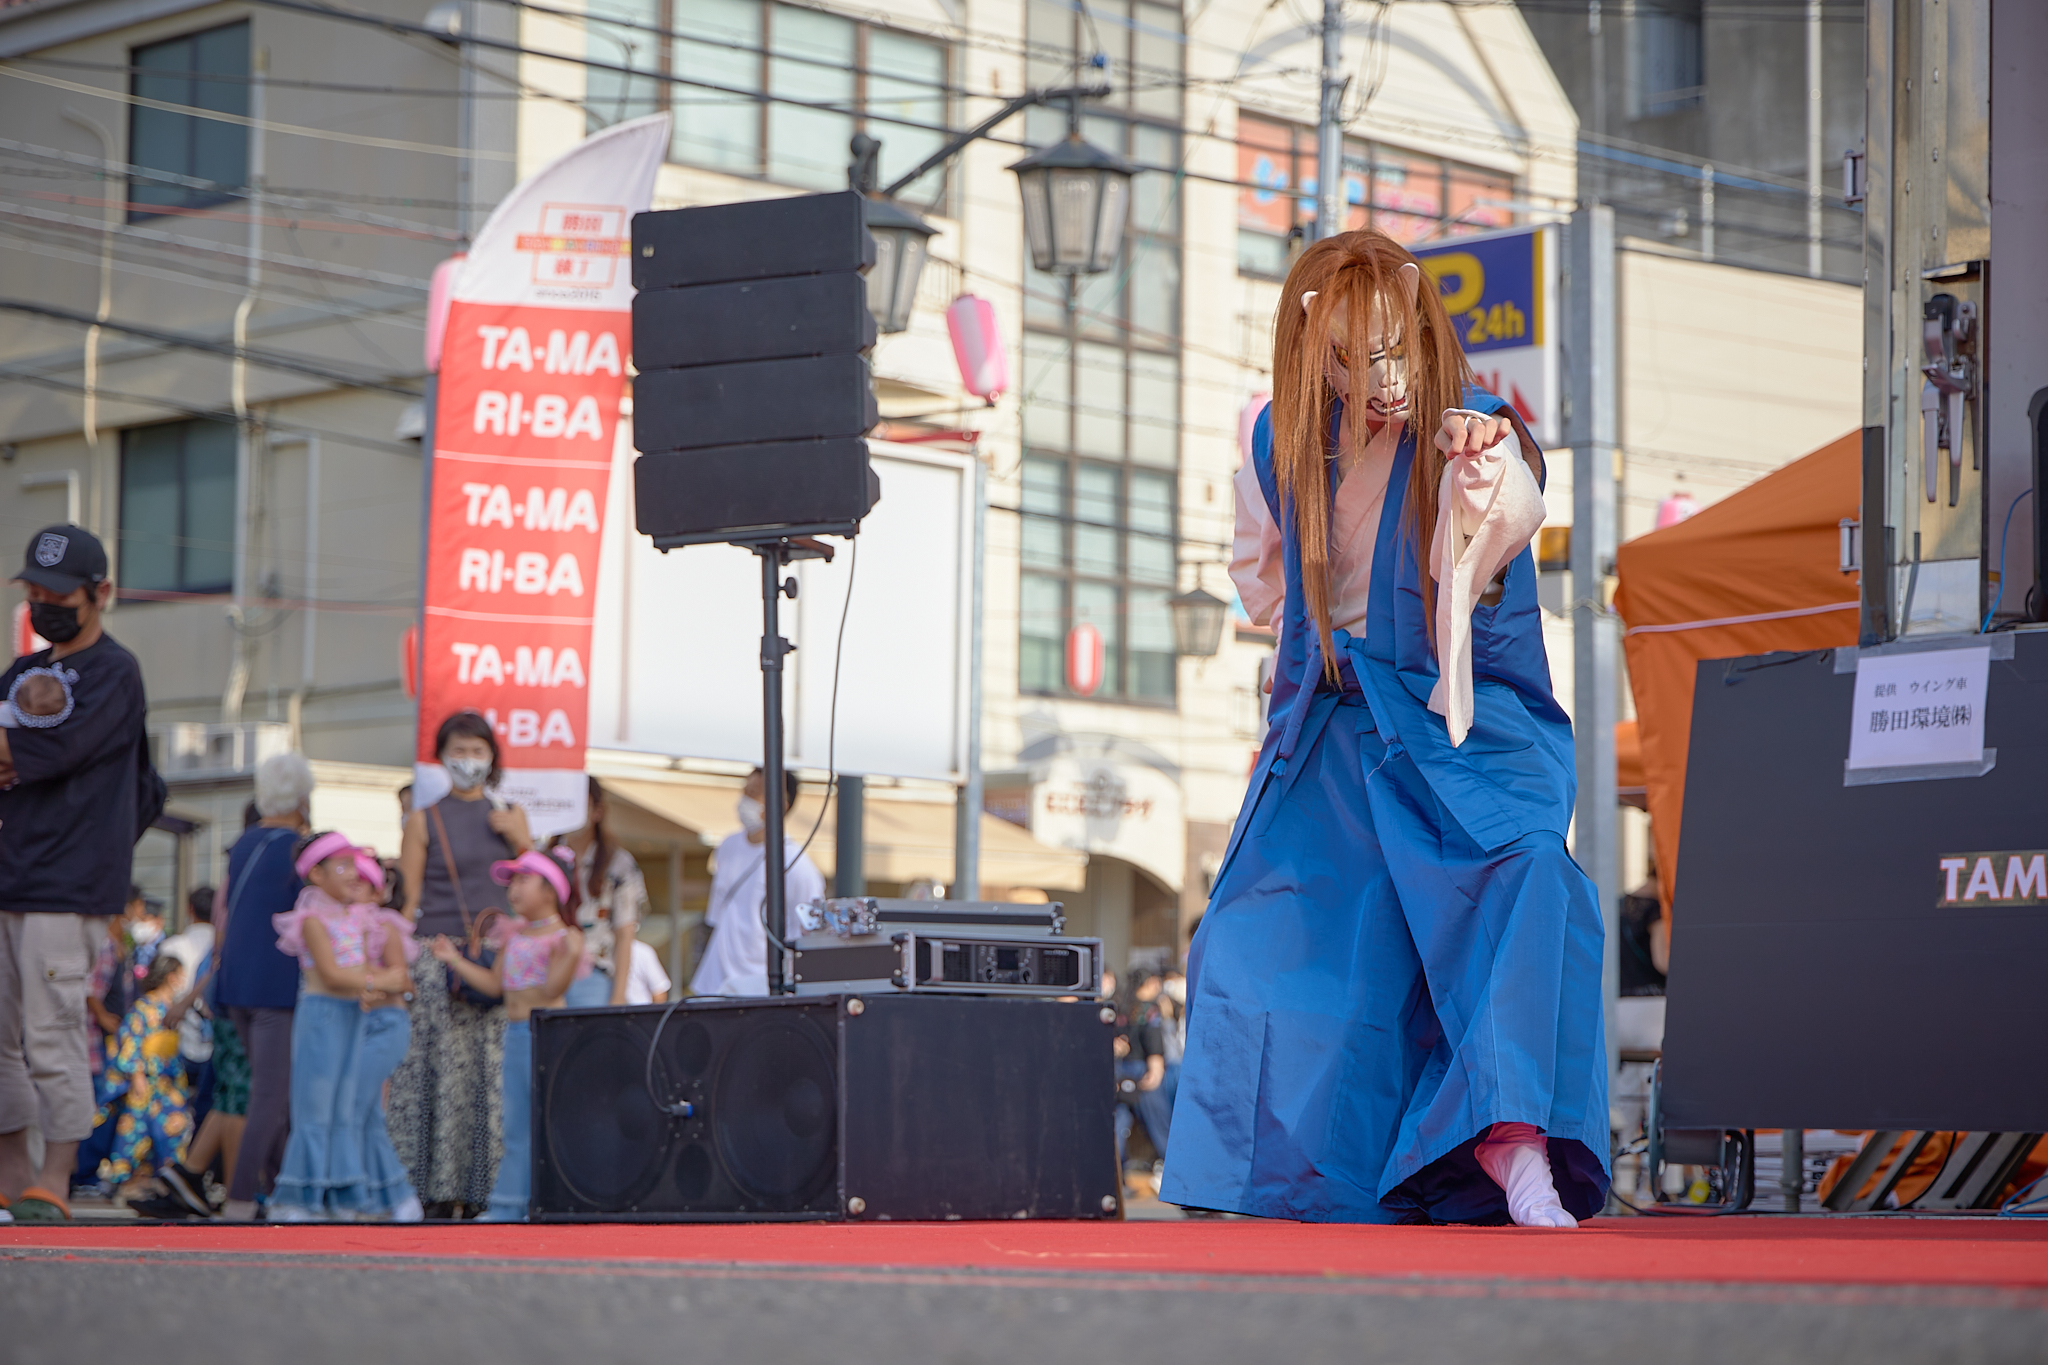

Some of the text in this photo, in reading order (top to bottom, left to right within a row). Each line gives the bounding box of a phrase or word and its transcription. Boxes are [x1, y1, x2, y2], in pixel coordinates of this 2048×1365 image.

[1466, 300, 1526, 344] 24h
[1874, 677, 1967, 698] 提供 ウイング車
[1939, 854, 2048, 903] TAM
